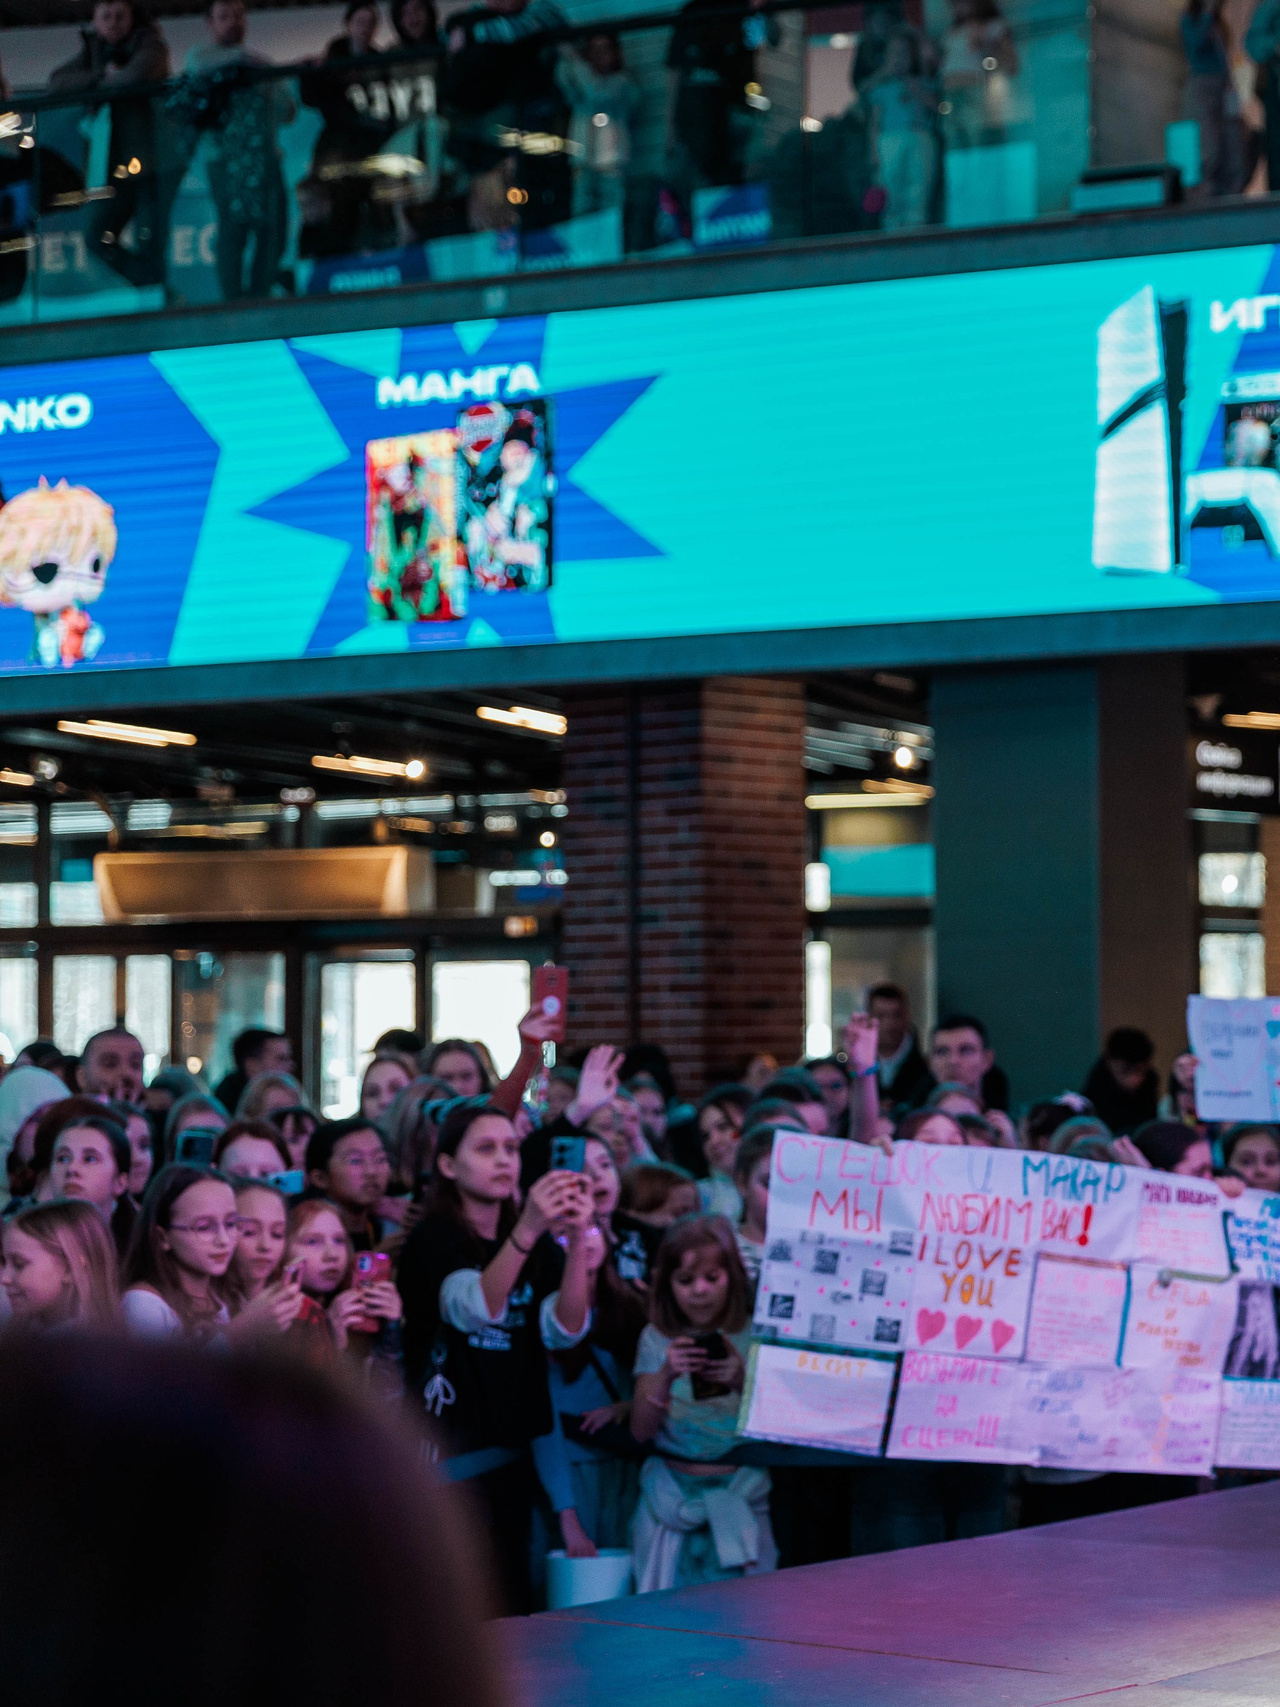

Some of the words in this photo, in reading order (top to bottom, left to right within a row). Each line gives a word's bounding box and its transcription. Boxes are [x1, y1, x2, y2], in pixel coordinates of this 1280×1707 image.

[377, 362, 540, 409] МАНГА
[808, 1187, 884, 1233] МЫ
[918, 1190, 1033, 1244] ЛЮБИМ
[917, 1234, 928, 1262] I
[934, 1236, 1022, 1277] LOVE
[941, 1270, 995, 1307] YOU
